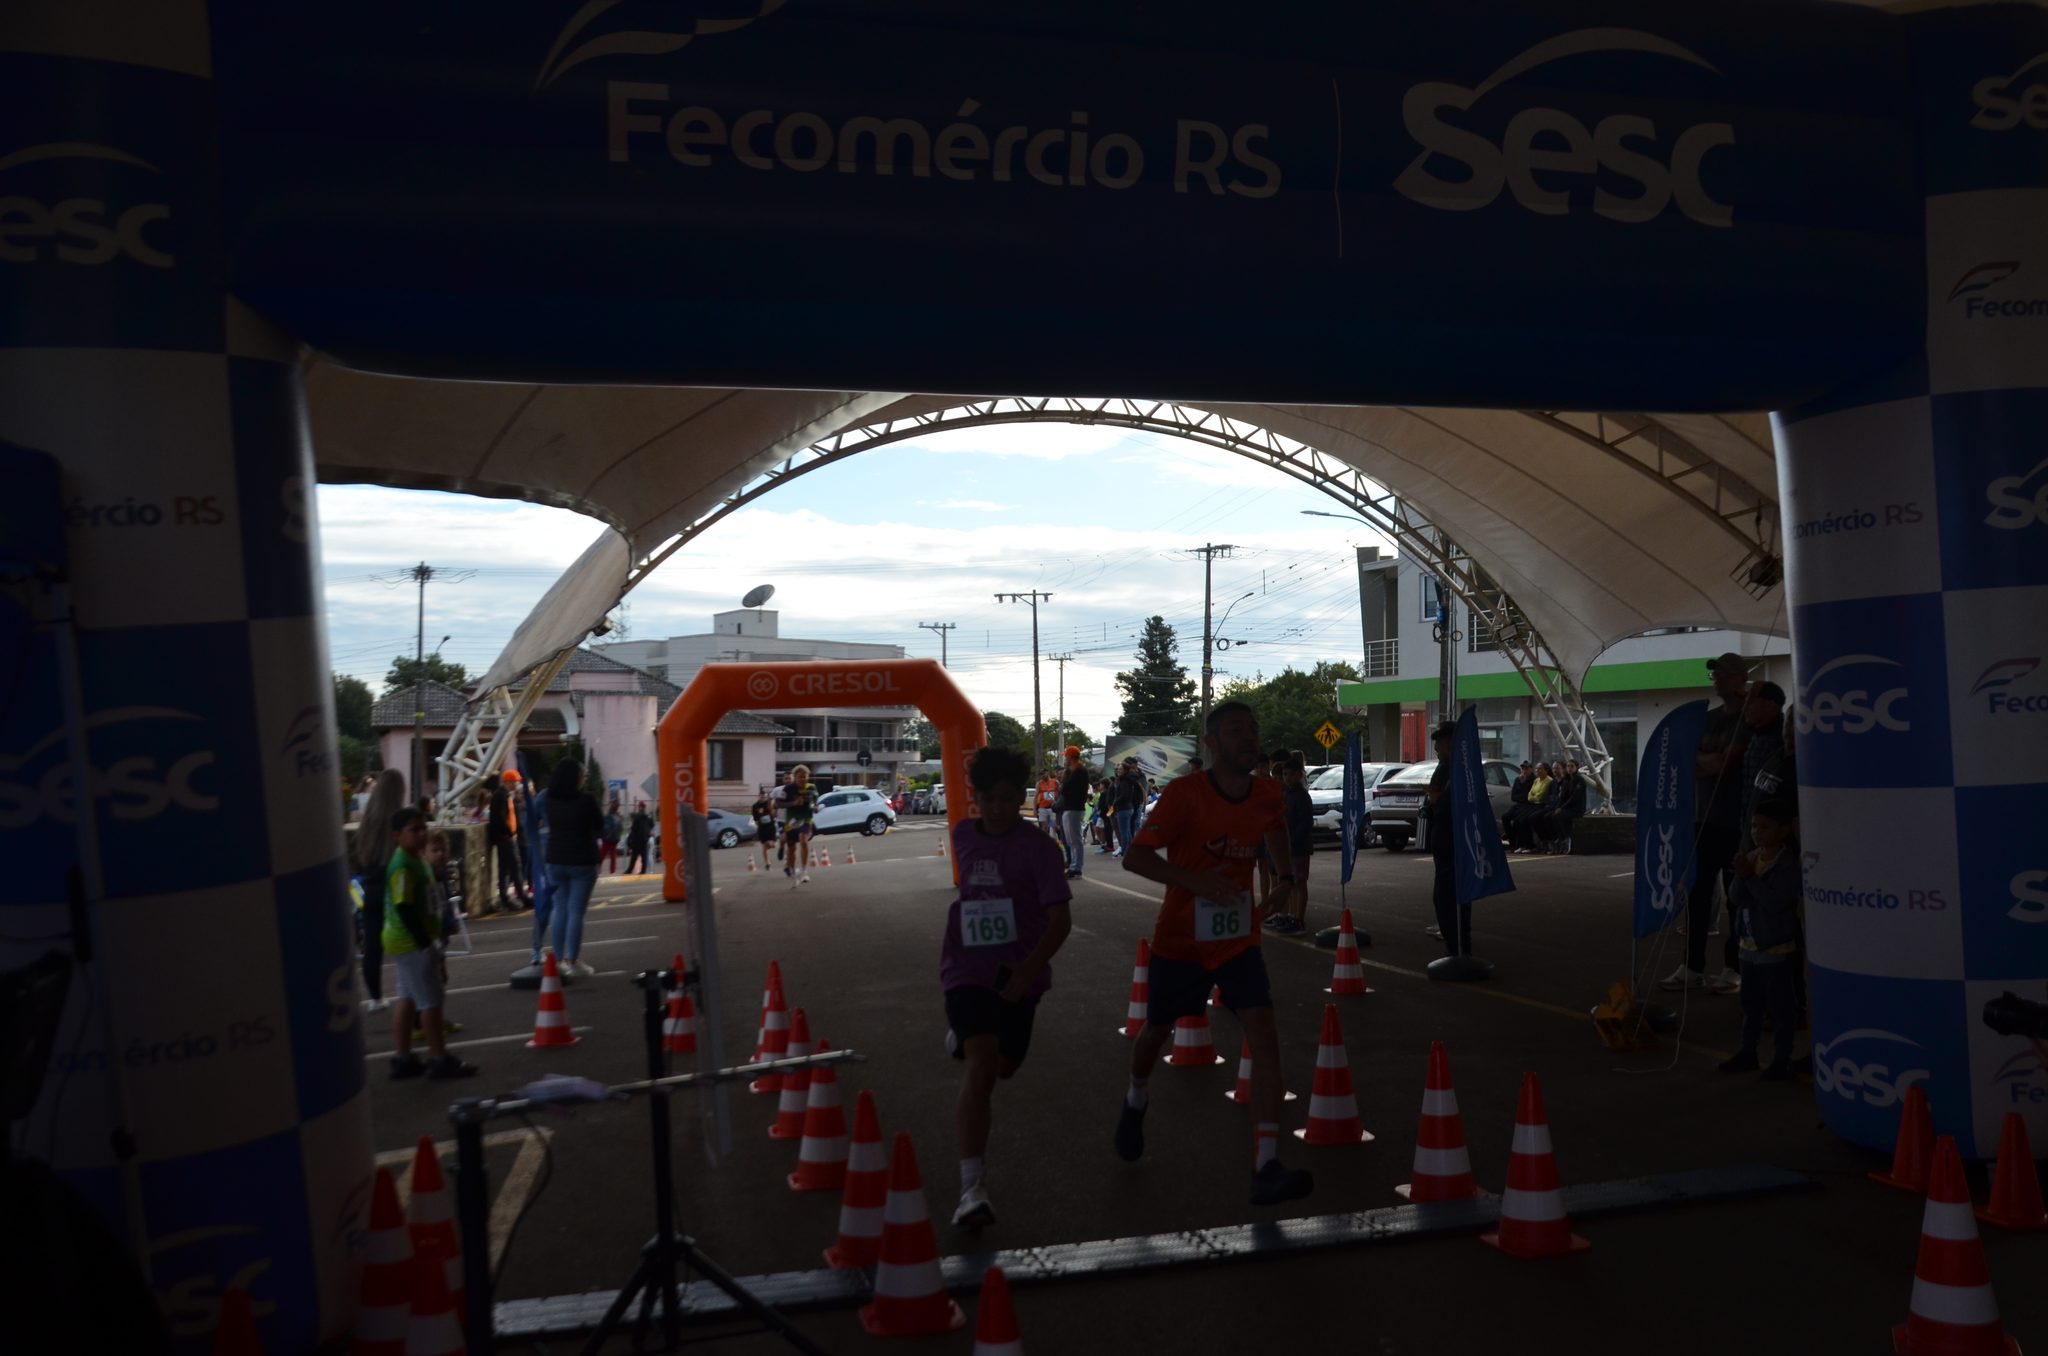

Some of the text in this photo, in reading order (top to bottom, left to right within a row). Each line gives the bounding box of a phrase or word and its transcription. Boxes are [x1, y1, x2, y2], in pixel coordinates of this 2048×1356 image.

[606, 80, 1283, 200] Fecomércio RS
[1391, 80, 1737, 229] Sesc
[174, 496, 225, 526] RS
[1884, 502, 1924, 527] RS
[1983, 474, 2048, 530] S
[787, 670, 901, 696] CRESOL
[1655, 727, 1670, 809] Fecomércio
[1753, 769, 1784, 795] VANS
[1666, 764, 1679, 809] Senac
[1651, 823, 1675, 912] Sesc
[1908, 888, 1947, 912] RS
[967, 915, 1009, 943] 169
[1211, 910, 1240, 937] 86
[228, 1016, 276, 1052] RS
